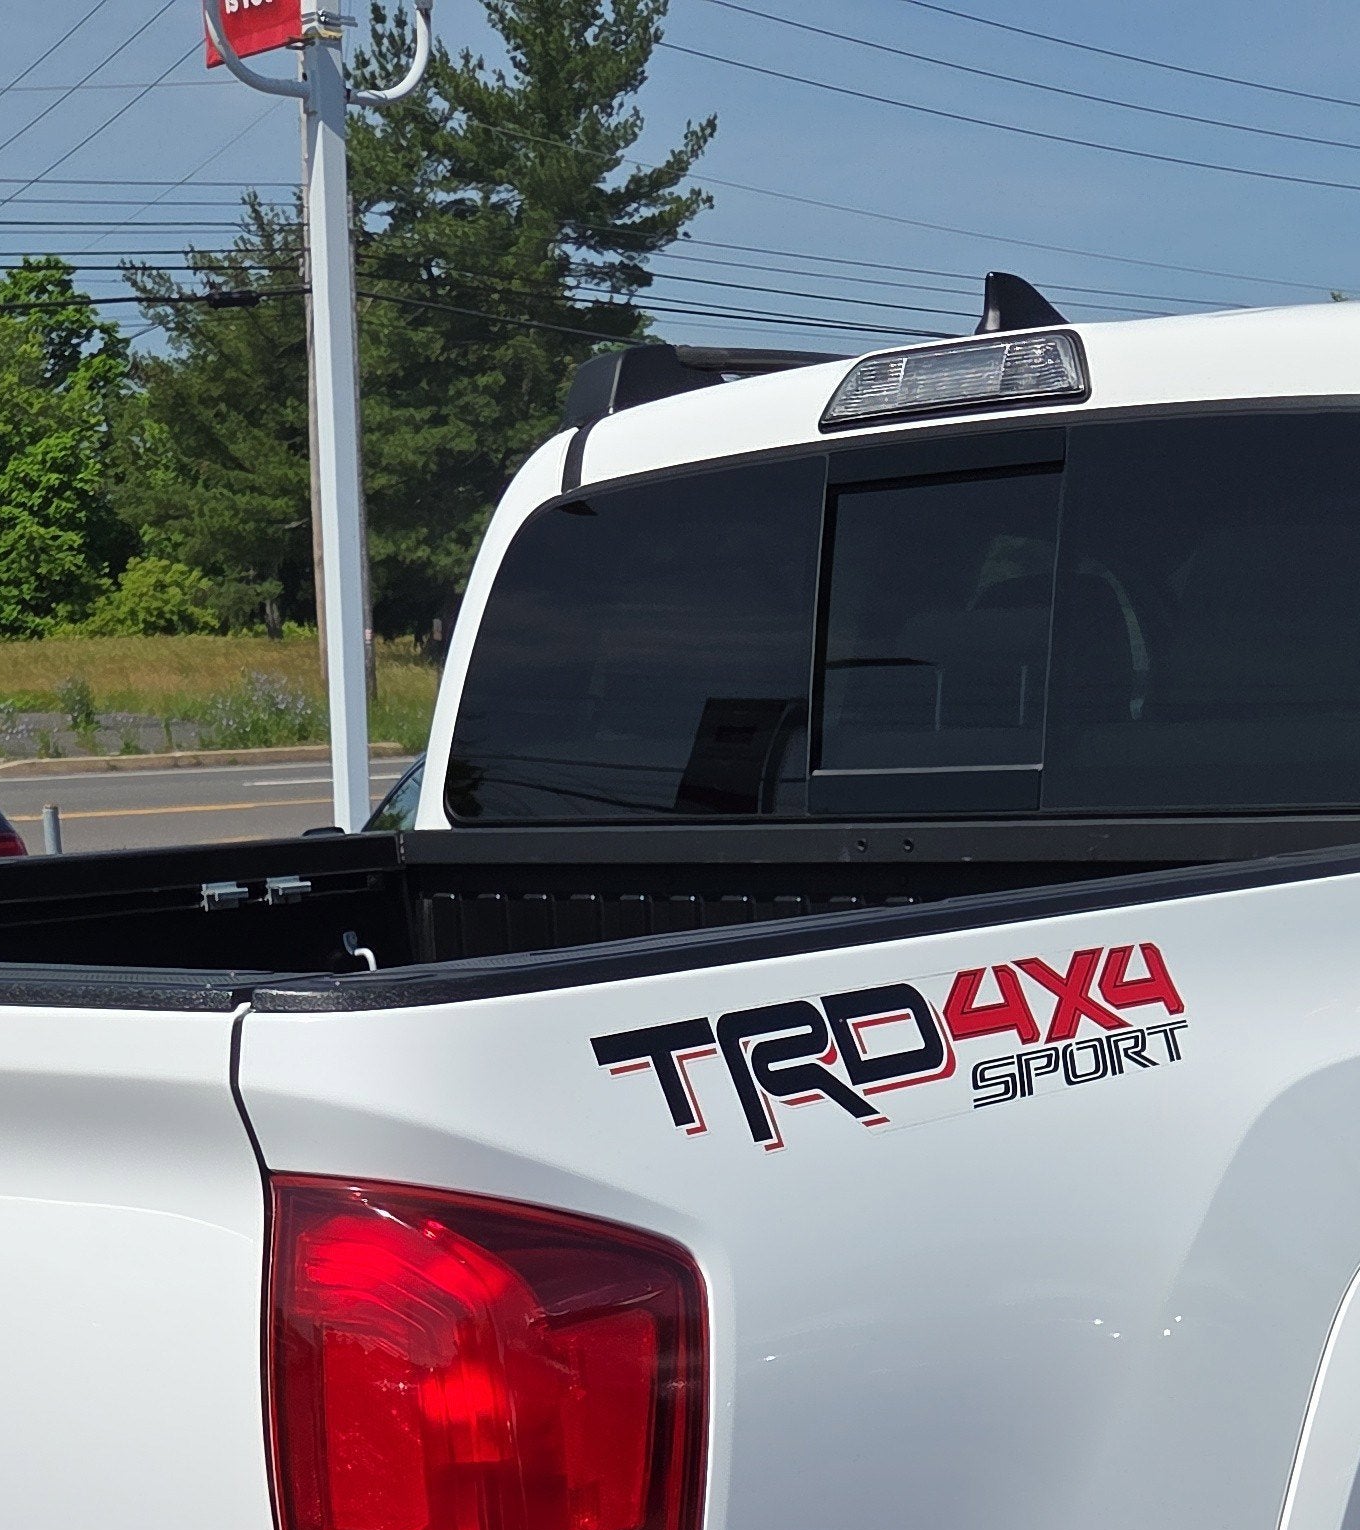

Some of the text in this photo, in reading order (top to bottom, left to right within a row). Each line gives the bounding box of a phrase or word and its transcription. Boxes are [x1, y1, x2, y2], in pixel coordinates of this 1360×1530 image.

[590, 942, 1186, 1152] TRD 4X4
[972, 1020, 1189, 1109] SPORT
